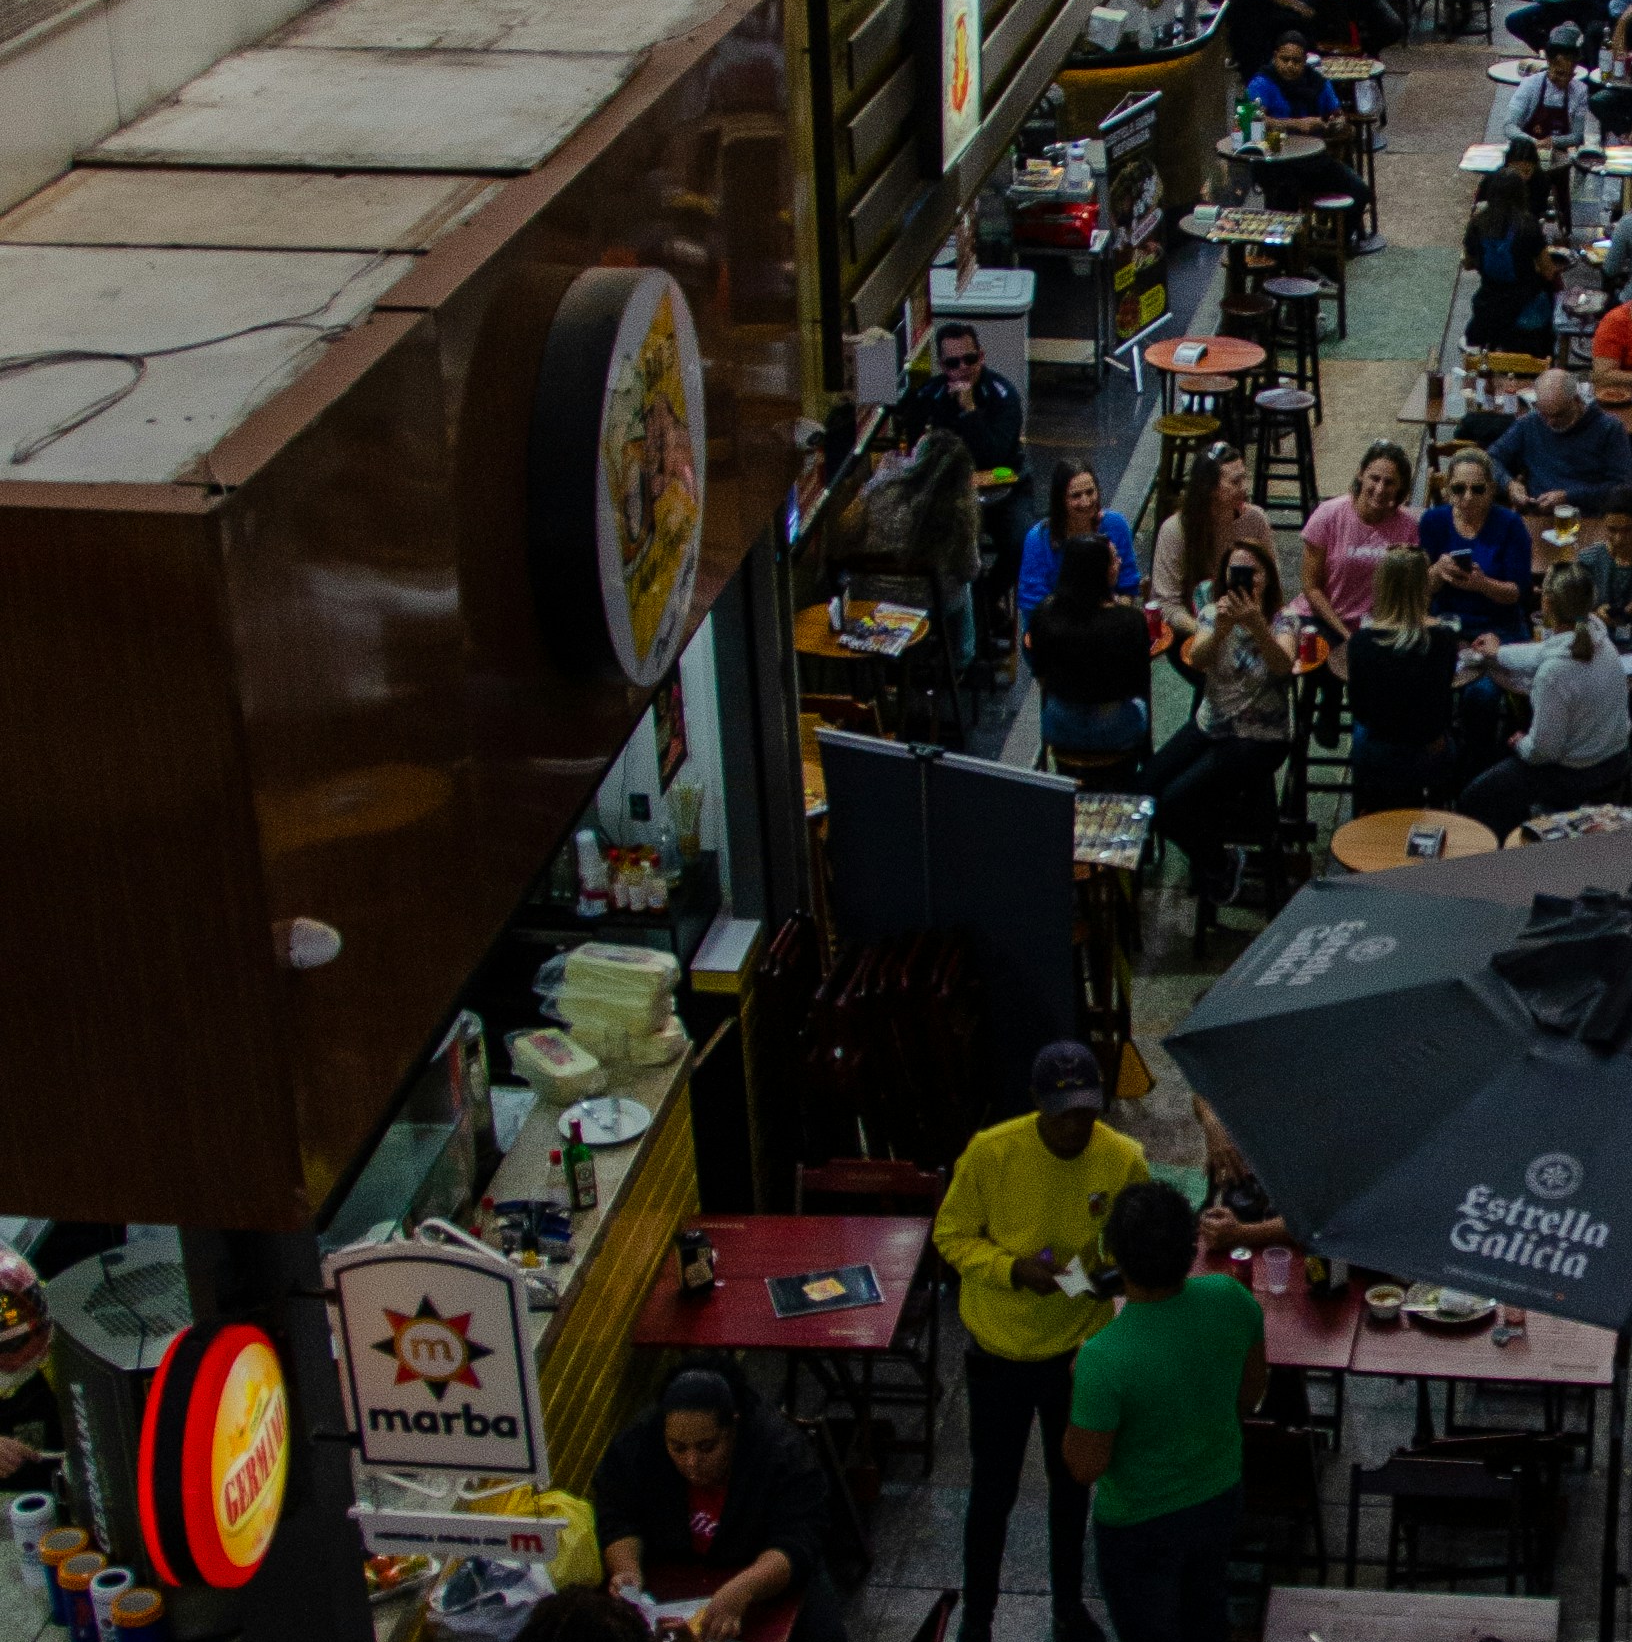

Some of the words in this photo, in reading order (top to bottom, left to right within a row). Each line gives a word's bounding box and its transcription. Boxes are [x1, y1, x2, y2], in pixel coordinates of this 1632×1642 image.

[1455, 1183, 1611, 1249] Estrella
[1450, 1217, 1590, 1280] Galicia
[368, 1403, 519, 1439] marba
